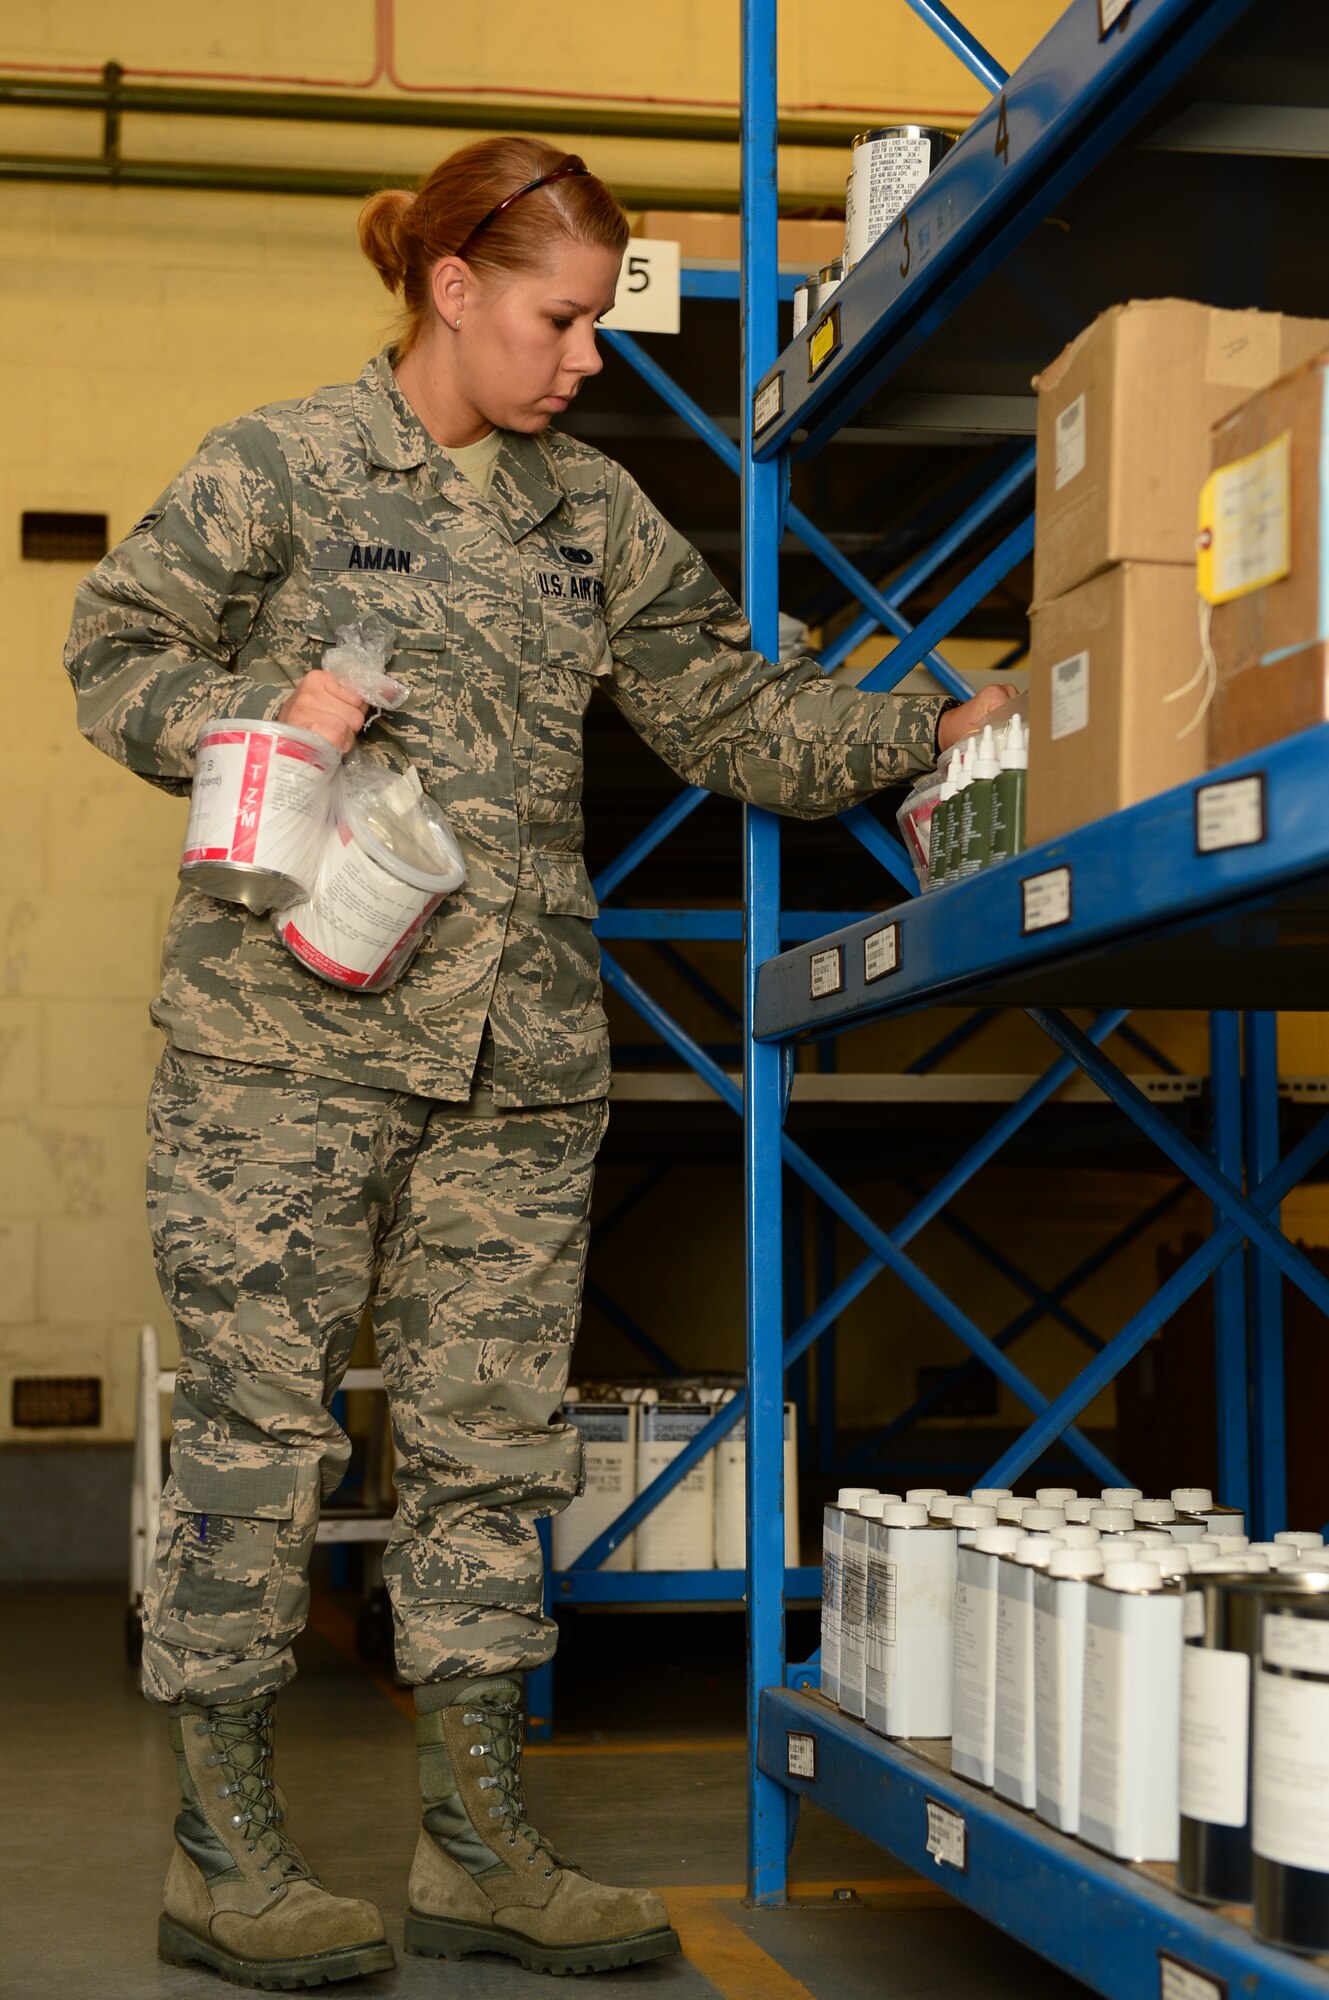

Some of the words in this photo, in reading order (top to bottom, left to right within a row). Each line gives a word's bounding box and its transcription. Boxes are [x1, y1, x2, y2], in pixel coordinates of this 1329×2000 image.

[995, 94, 1009, 166] 4
[900, 213, 910, 278] 3
[628, 257, 649, 293] 5
[348, 545, 411, 574] AMAN
[538, 573, 566, 597] U.S.
[570, 576, 591, 600] AIR
